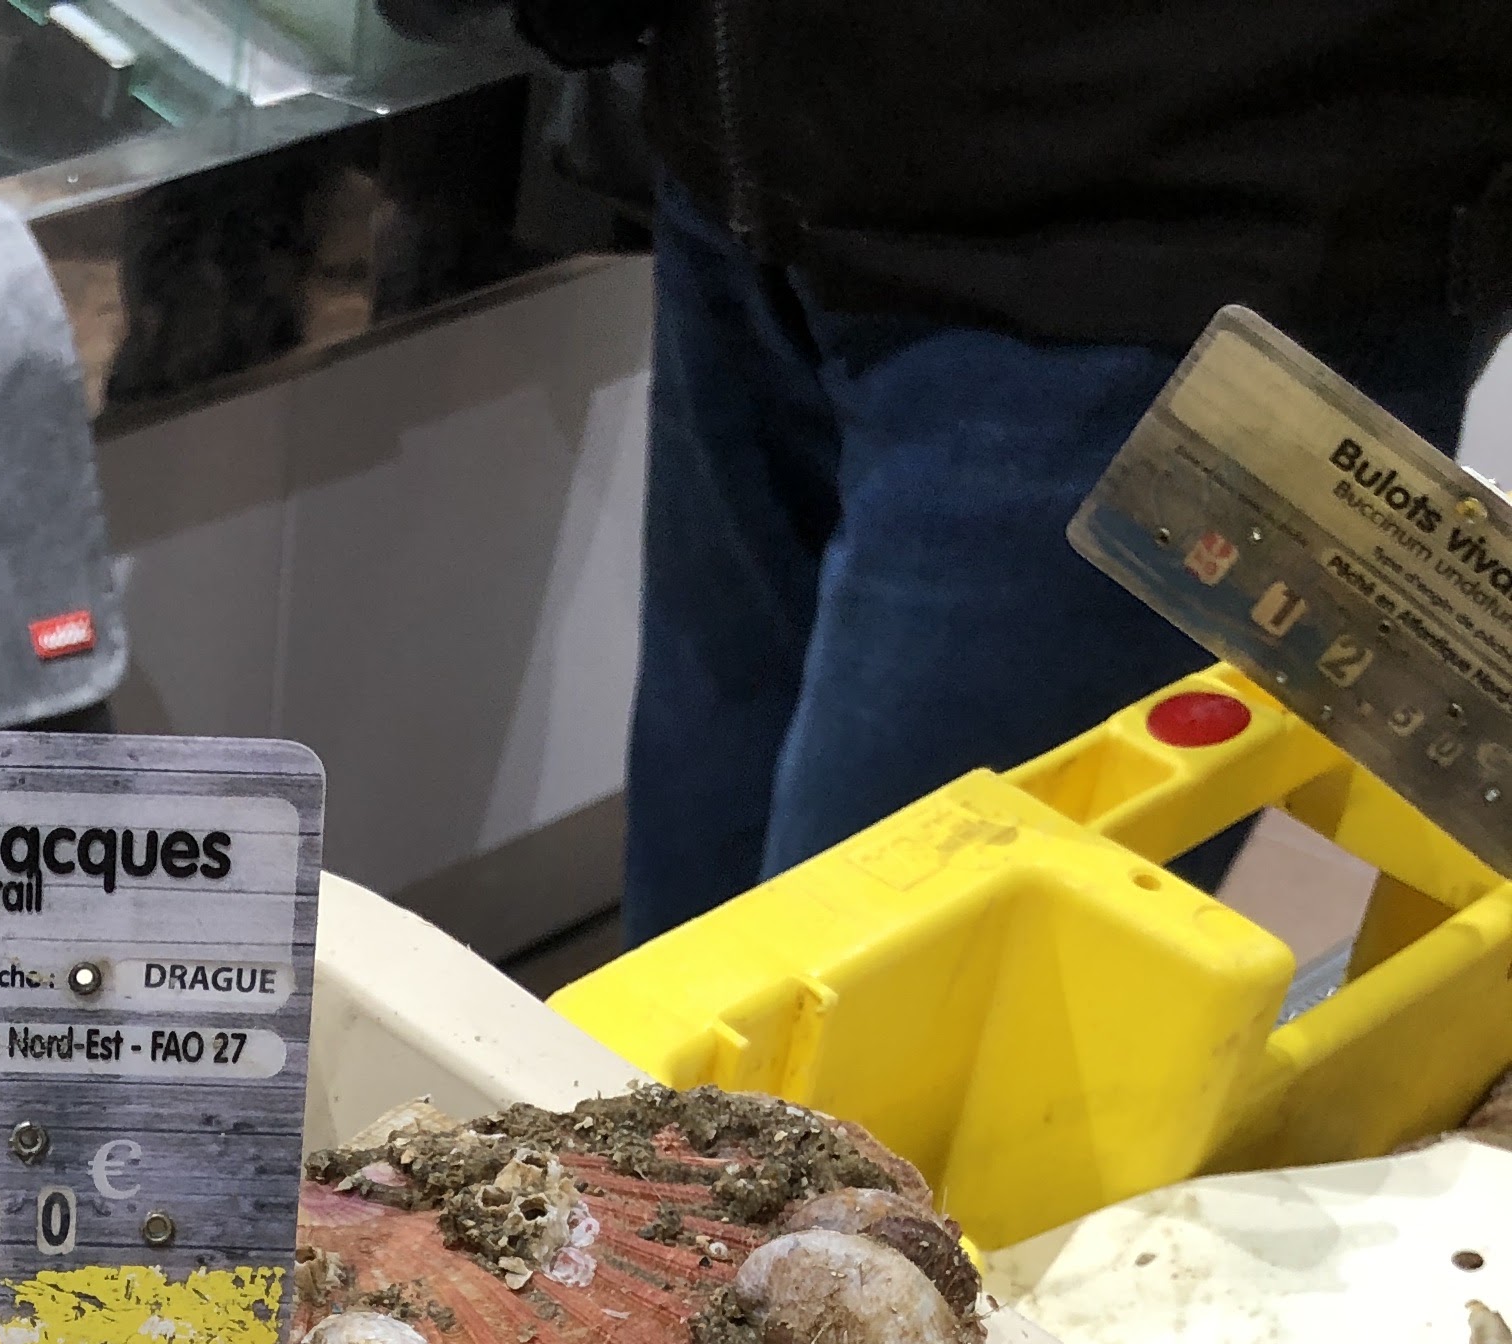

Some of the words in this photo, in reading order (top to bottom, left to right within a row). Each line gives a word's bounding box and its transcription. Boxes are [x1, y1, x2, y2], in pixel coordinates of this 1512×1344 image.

[1329, 438, 1442, 533] Bulots
[1332, 480, 1433, 561] Buccinum
[143, 963, 278, 994] DRAGUE
[7, 1025, 125, 1062] Nord-Est
[150, 1031, 206, 1064] FAO
[213, 1033, 248, 1065] 27
